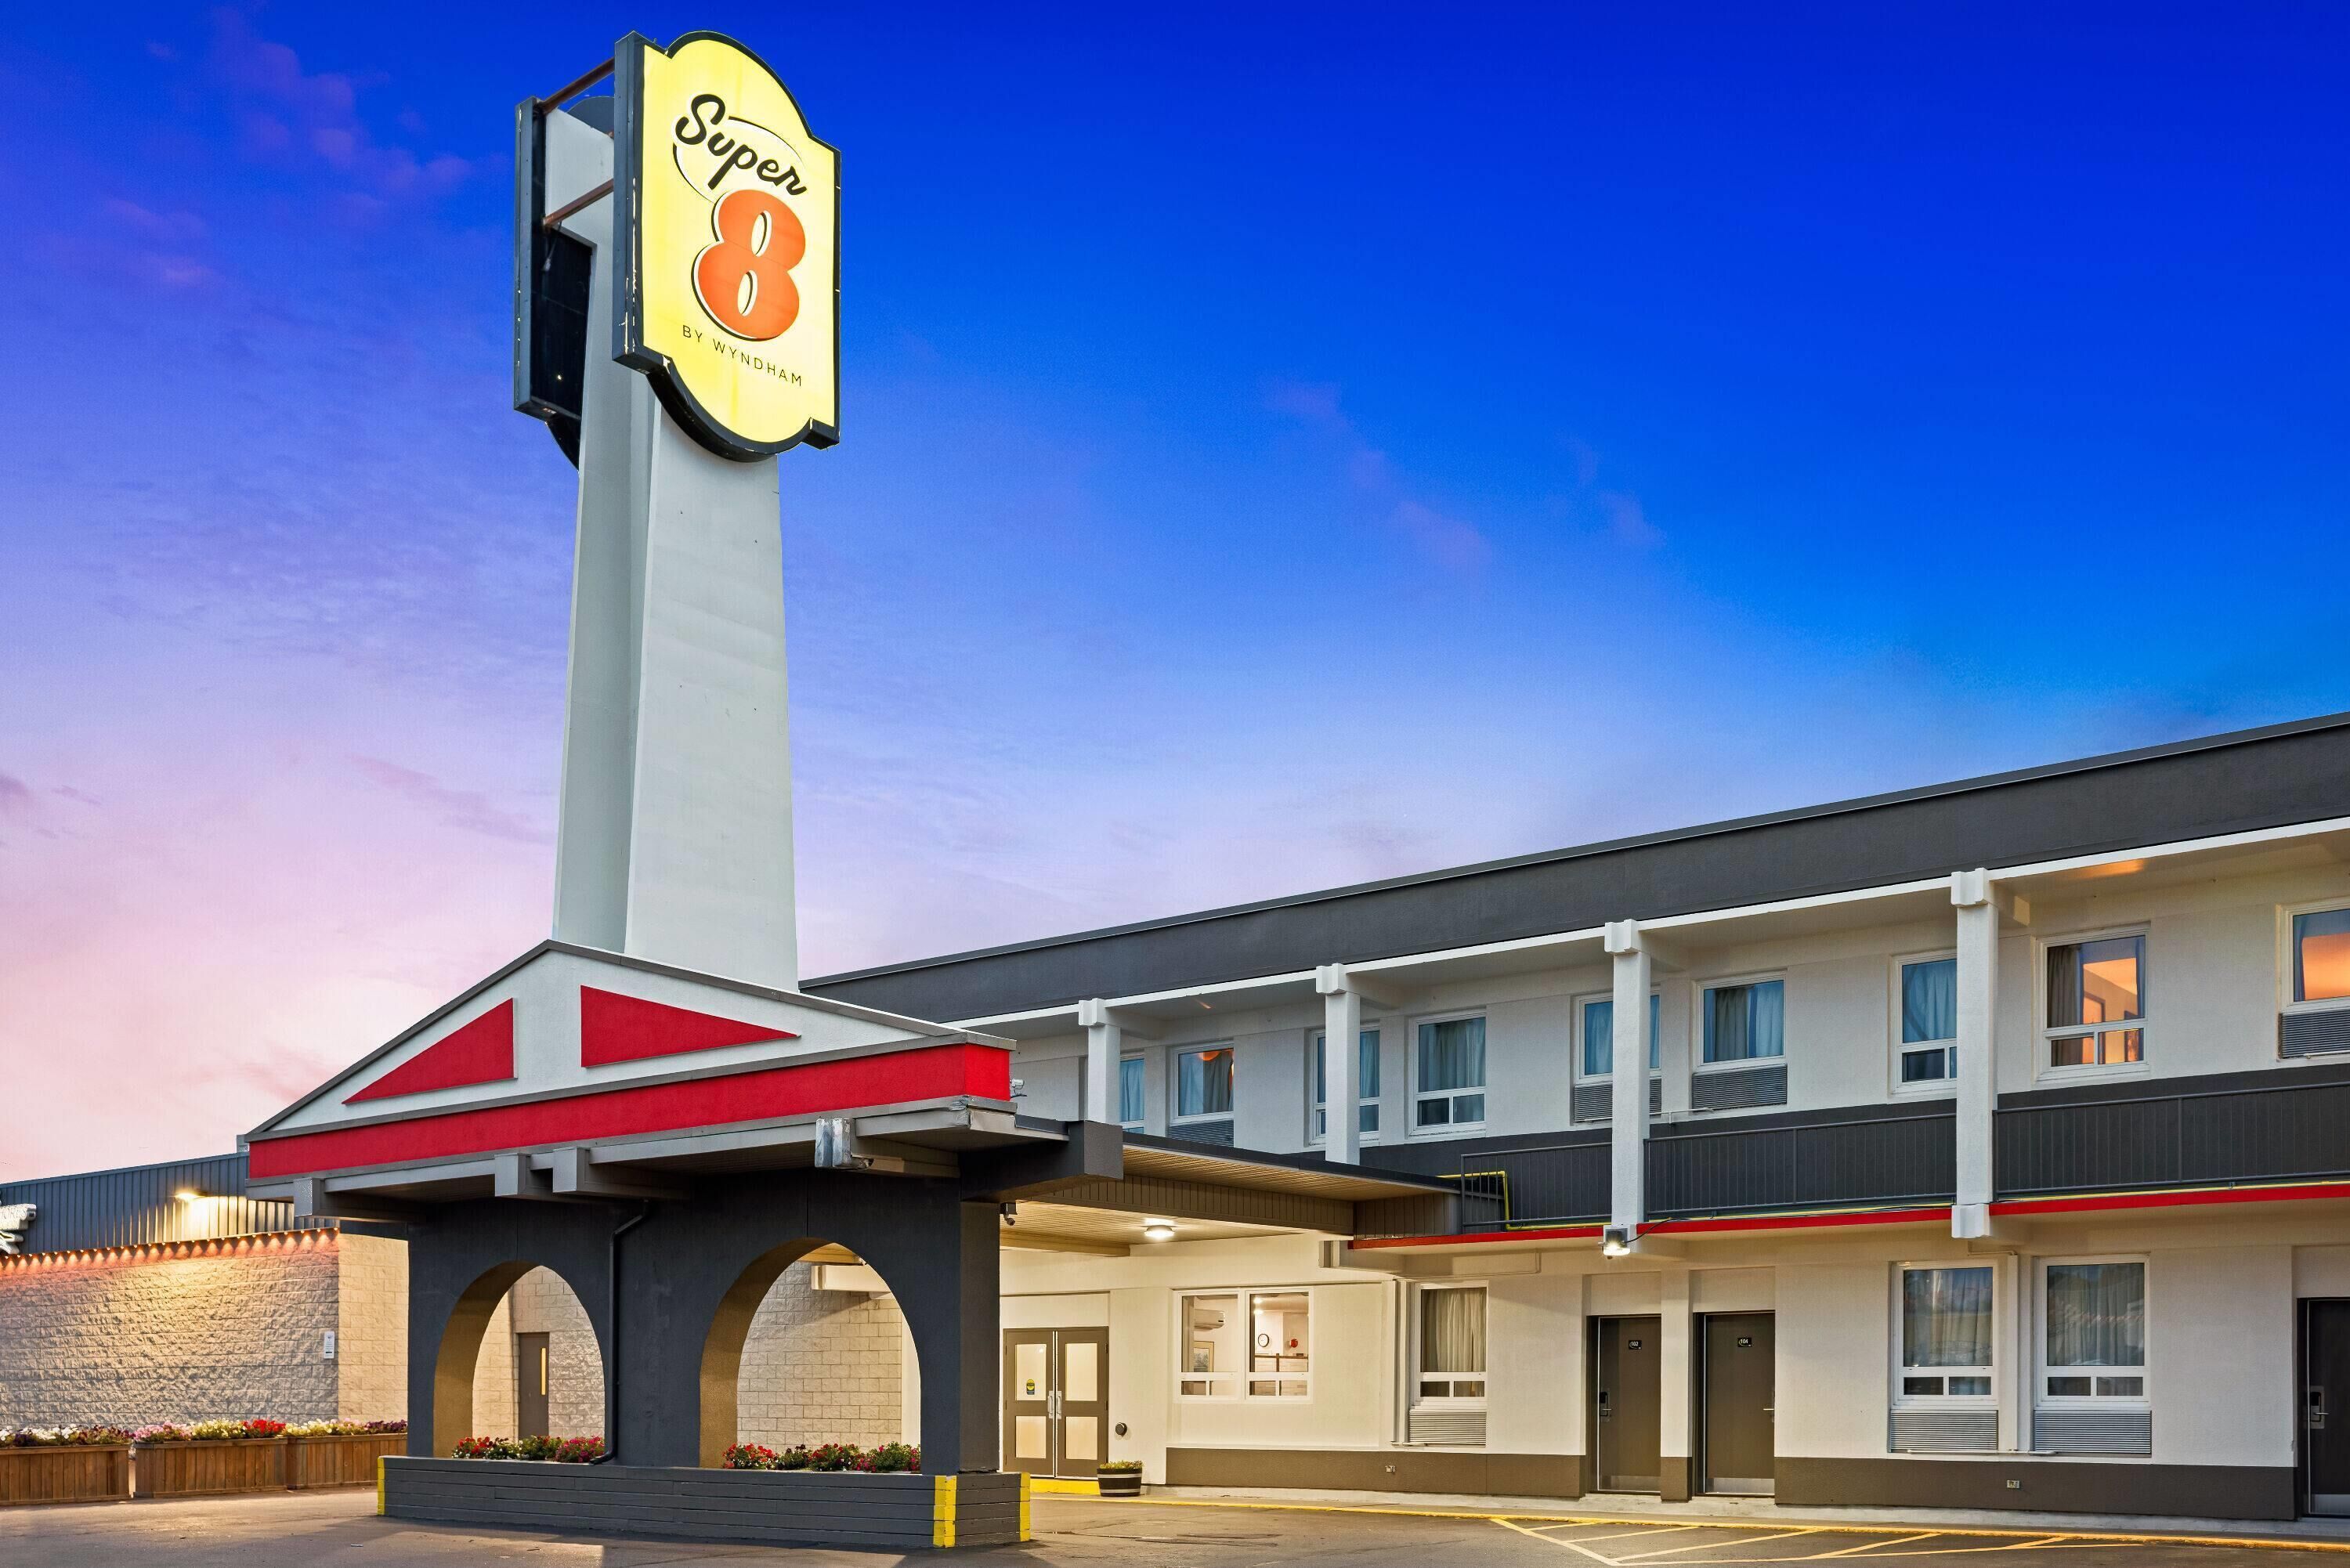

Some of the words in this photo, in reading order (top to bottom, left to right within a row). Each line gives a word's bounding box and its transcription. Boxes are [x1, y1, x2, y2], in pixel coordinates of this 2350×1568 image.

[675, 94, 808, 196] Super
[691, 189, 806, 342] 8
[682, 324, 703, 343] BY
[712, 338, 802, 387] WYNDHAM
